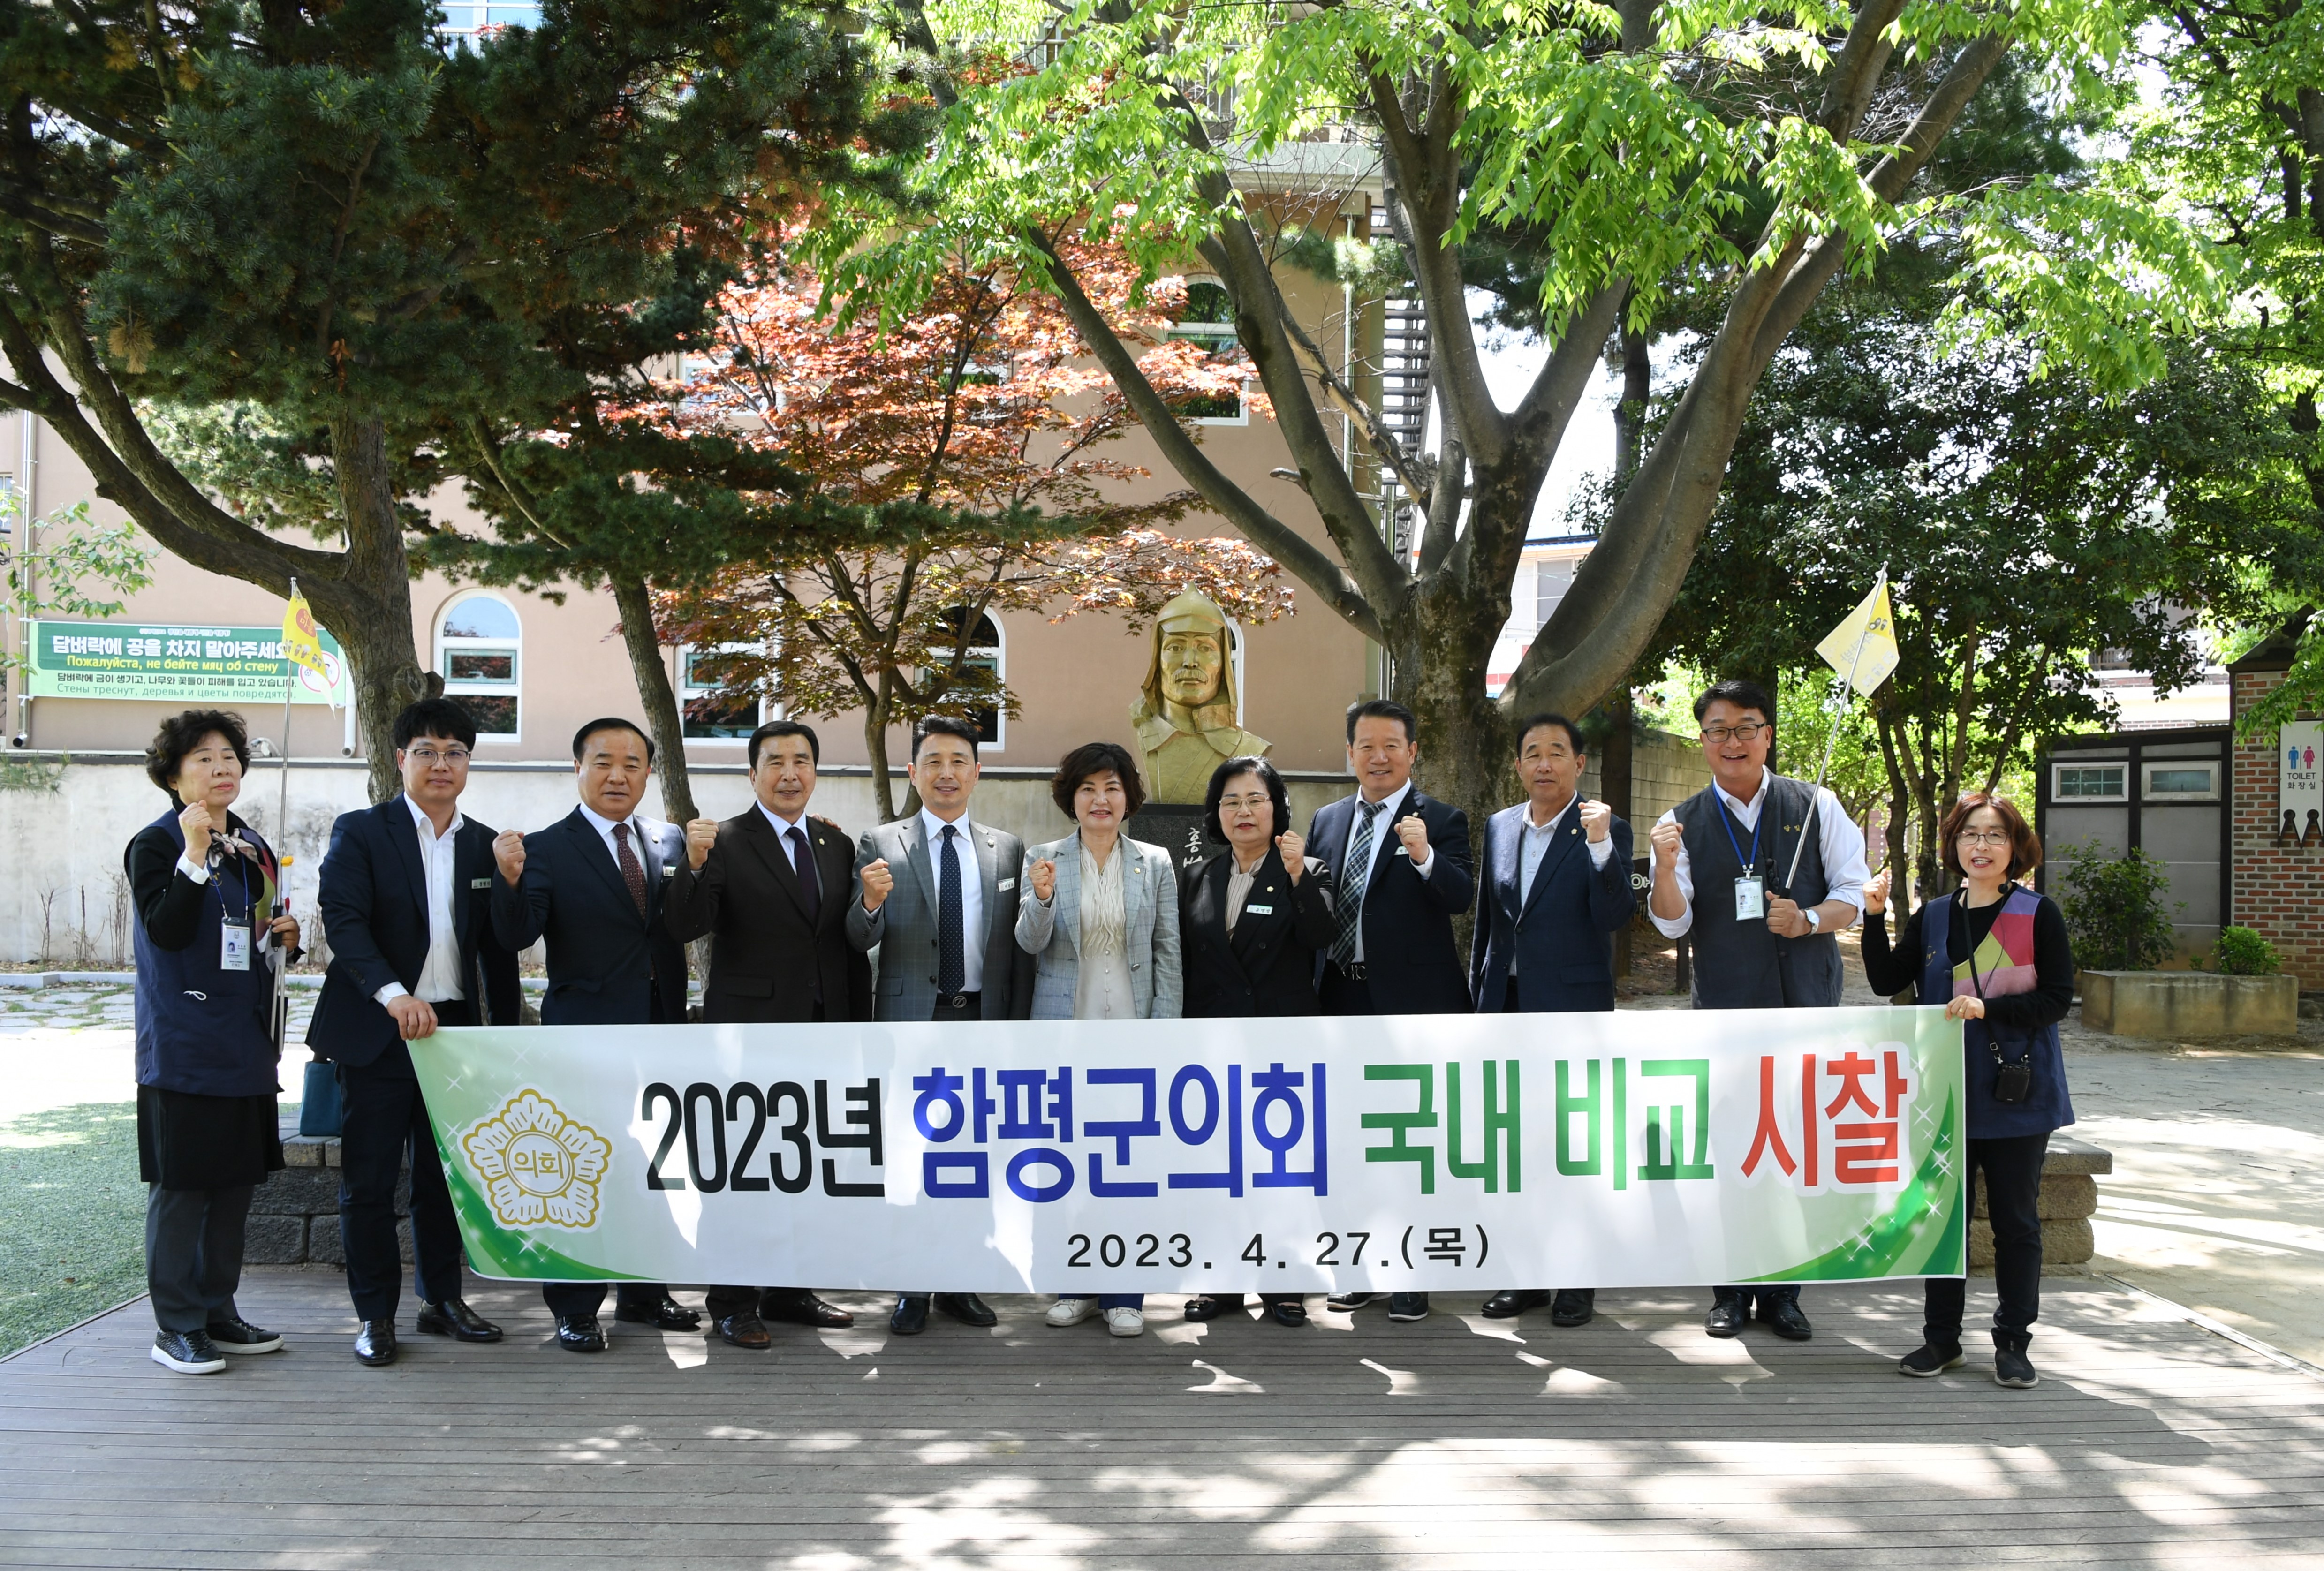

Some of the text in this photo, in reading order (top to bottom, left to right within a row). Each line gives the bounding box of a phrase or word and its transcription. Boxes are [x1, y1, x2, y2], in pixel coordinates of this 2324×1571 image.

[53, 635, 122, 656] 담벼락에
[126, 638, 161, 657] 공을
[166, 640, 201, 658] 차지
[67, 655, 142, 671] Пожалуйста,
[146, 660, 161, 669] не
[164, 659, 198, 670] бейте
[226, 660, 241, 671] об
[244, 662, 279, 674] стену
[57, 673, 93, 682] 담벼락에
[96, 674, 114, 683] 금이
[116, 675, 145, 685] 생기고,
[148, 676, 175, 685] 나무와
[178, 677, 205, 686] 꽃들이
[208, 678, 234, 686] 피해를
[237, 678, 256, 687] 입고
[57, 683, 90, 693] Стены
[93, 686, 138, 696] треснут,
[142, 687, 184, 697] деревья
[642, 1051, 1908, 1203] 2023년 함평군의회 국내 비교 시찰
[514, 1150, 564, 1179] 의회
[1067, 1224, 1490, 1269] 2023. 4. 27.(목)
